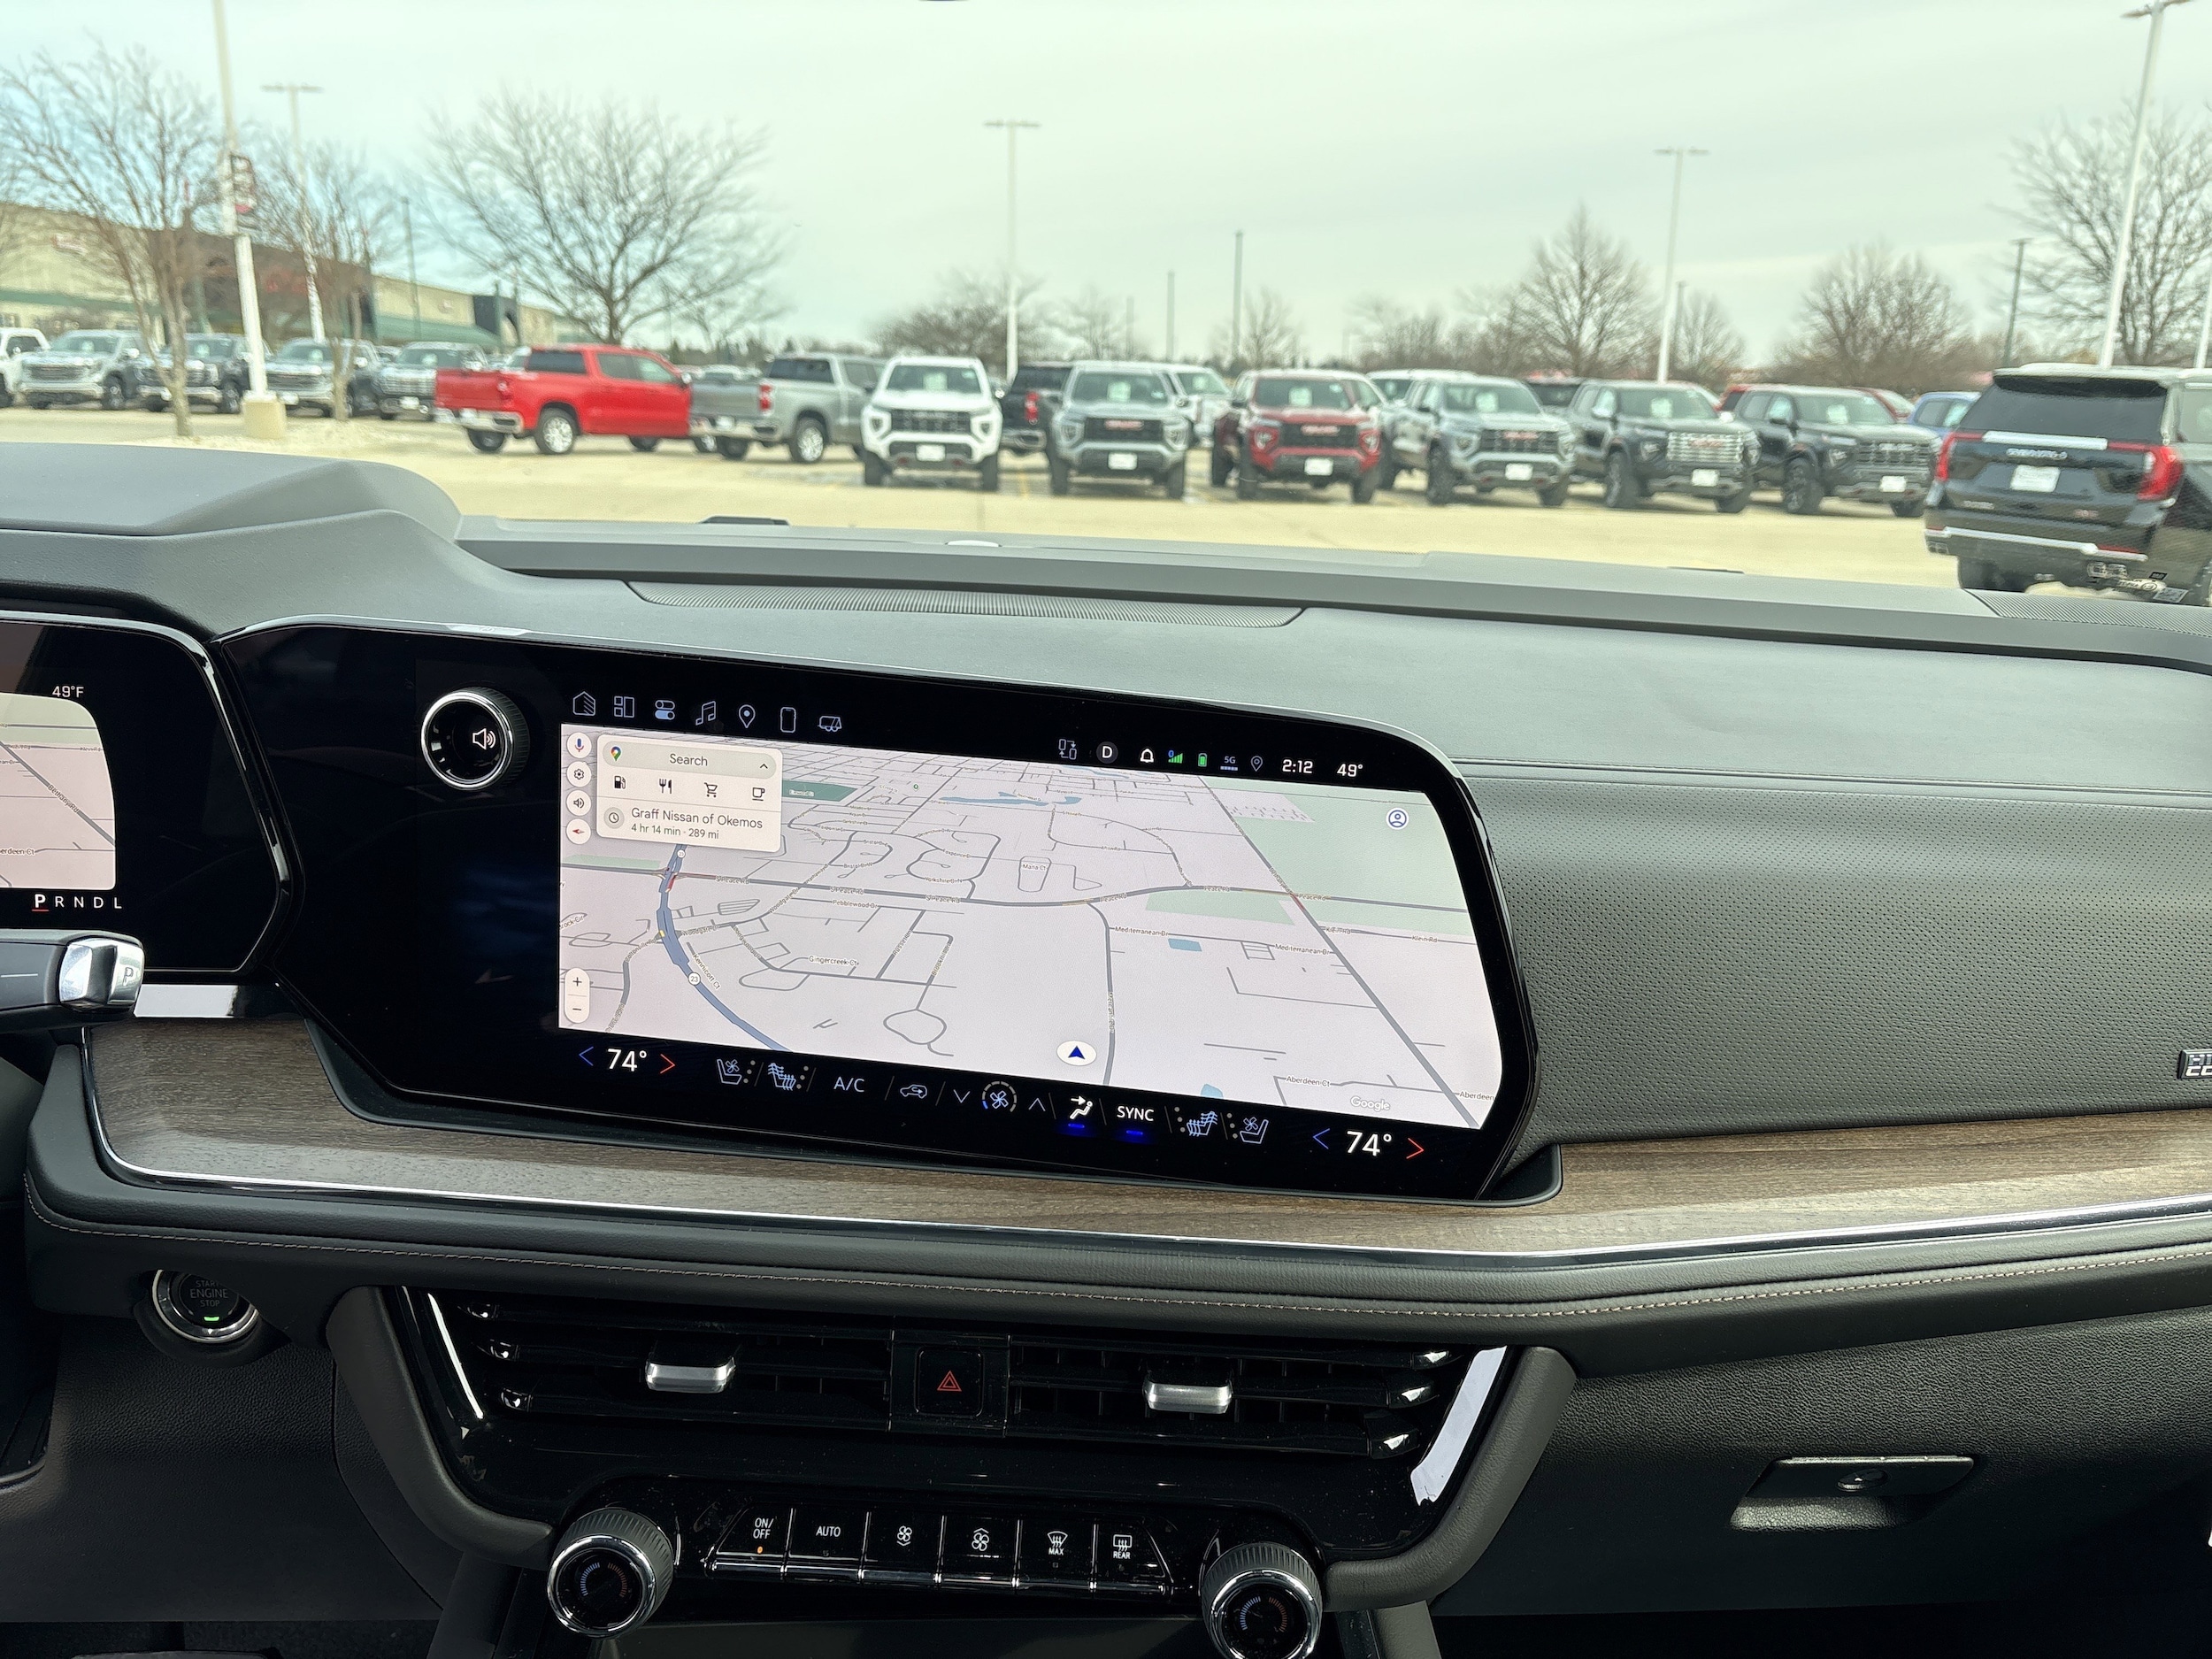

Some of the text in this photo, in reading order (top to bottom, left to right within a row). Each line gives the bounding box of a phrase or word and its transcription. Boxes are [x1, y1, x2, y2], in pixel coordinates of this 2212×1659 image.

[52, 685, 84, 698] 49°F
[1102, 746, 1112, 758] D
[669, 753, 708, 766] Search
[1224, 756, 1236, 764] 5G
[1282, 759, 1313, 774] 2:12
[1337, 763, 1363, 777] 49°
[631, 807, 763, 828] Graff Nissan of Okemos
[652, 825, 661, 833] 14
[664, 826, 680, 836] min
[688, 828, 705, 838] 289
[708, 830, 719, 839] mi
[35, 894, 122, 909] P R N D L
[833, 899, 869, 908] Pebblewood
[1115, 926, 1160, 936] Mediterranean
[1275, 943, 1322, 954] Mediterranean
[809, 956, 849, 964] Gingercreek
[693, 954, 715, 983] Kennicott
[607, 1048, 647, 1072] 74°
[833, 1076, 865, 1093] A/C
[1286, 1076, 1320, 1086] Aberdeen
[1459, 1091, 1494, 1101] Aberdeen
[1350, 1096, 1391, 1112] Google
[1117, 1105, 1155, 1122] SYNC
[1347, 1130, 1392, 1156] 74°
[190, 1289, 229, 1298] ENGINE
[200, 1299, 220, 1308] STOP
[754, 1517, 774, 1529] ON/
[753, 1528, 772, 1539] OFF
[815, 1525, 841, 1538] AUTO
